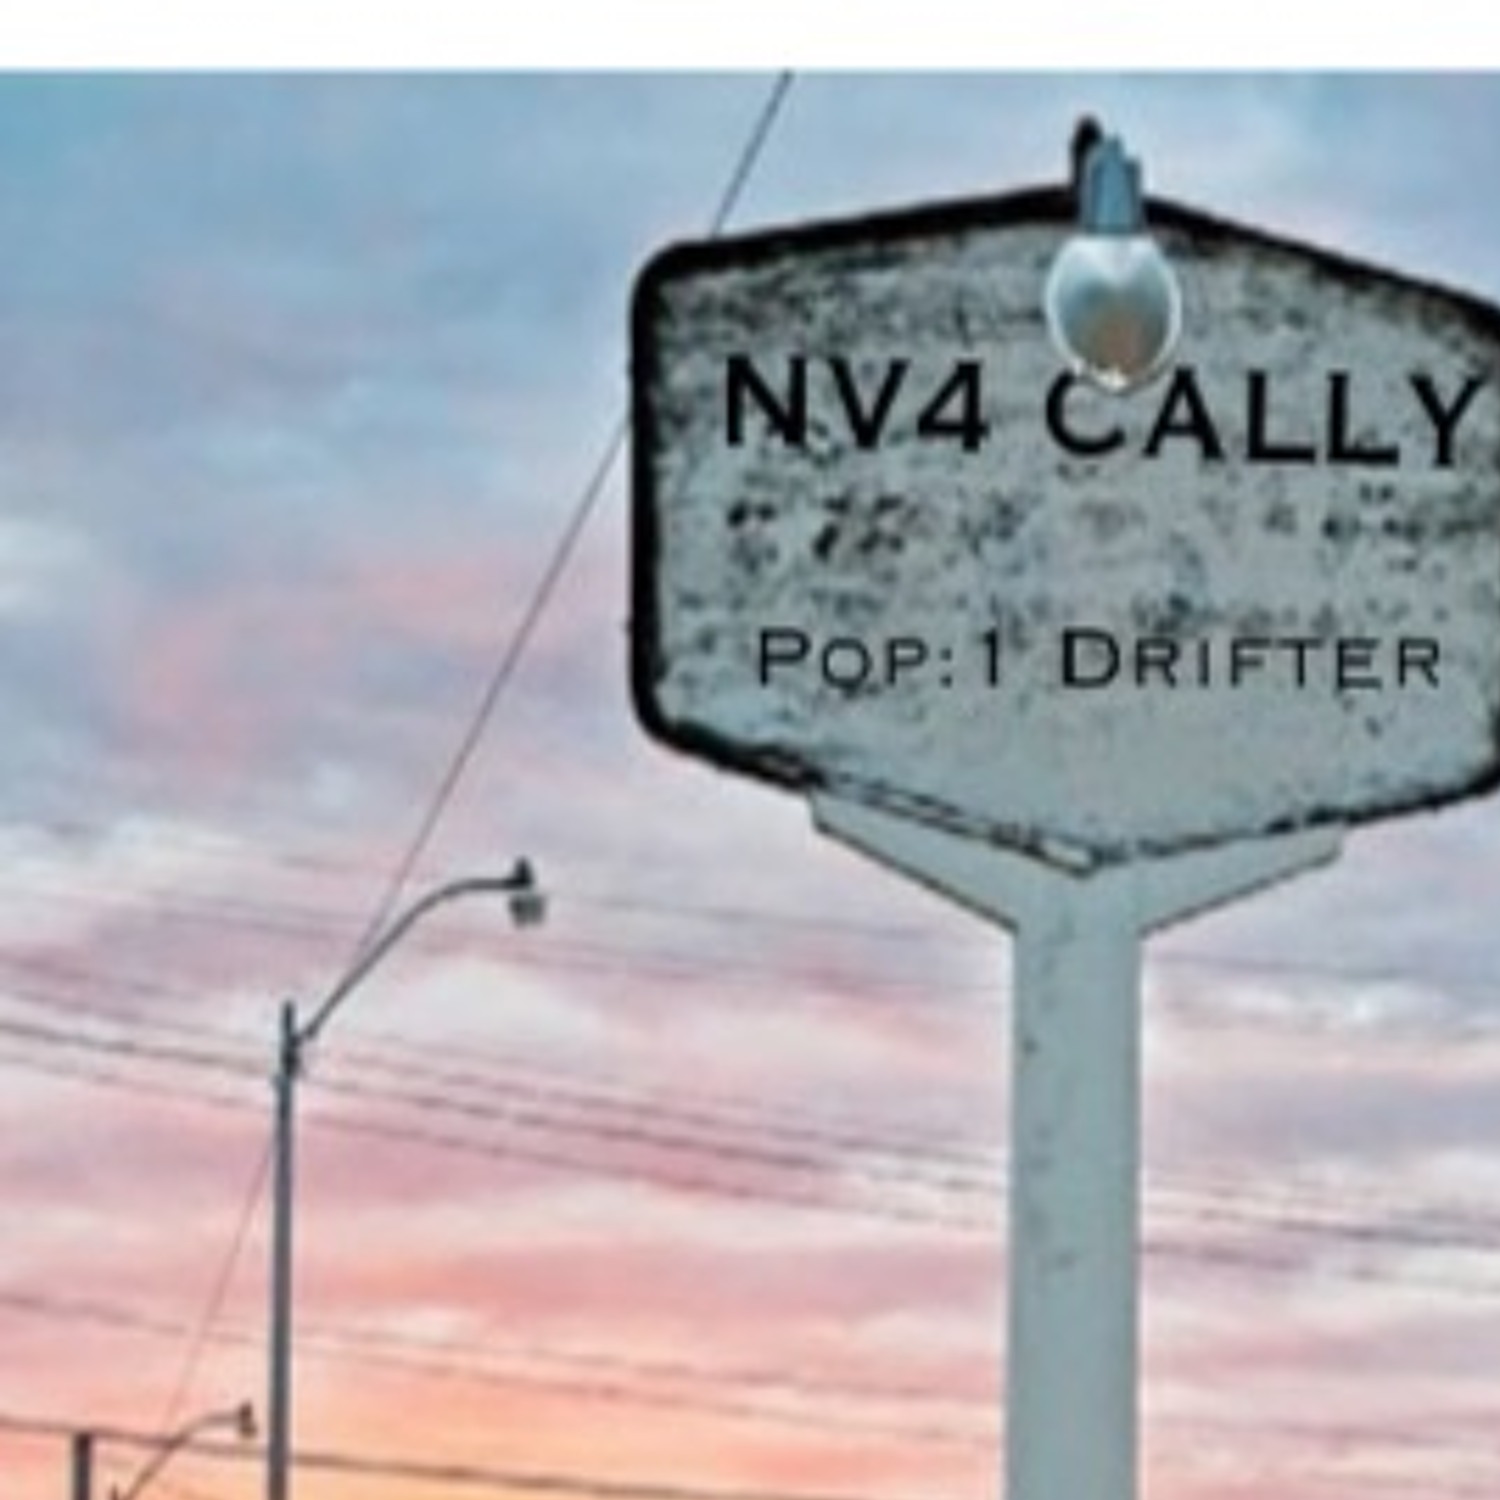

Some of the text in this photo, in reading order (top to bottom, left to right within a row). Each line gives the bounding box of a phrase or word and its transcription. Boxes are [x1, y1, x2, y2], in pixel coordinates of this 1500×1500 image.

[724, 355, 1487, 466] NV4 CALLY
[1061, 628, 1440, 689] DRIFTER
